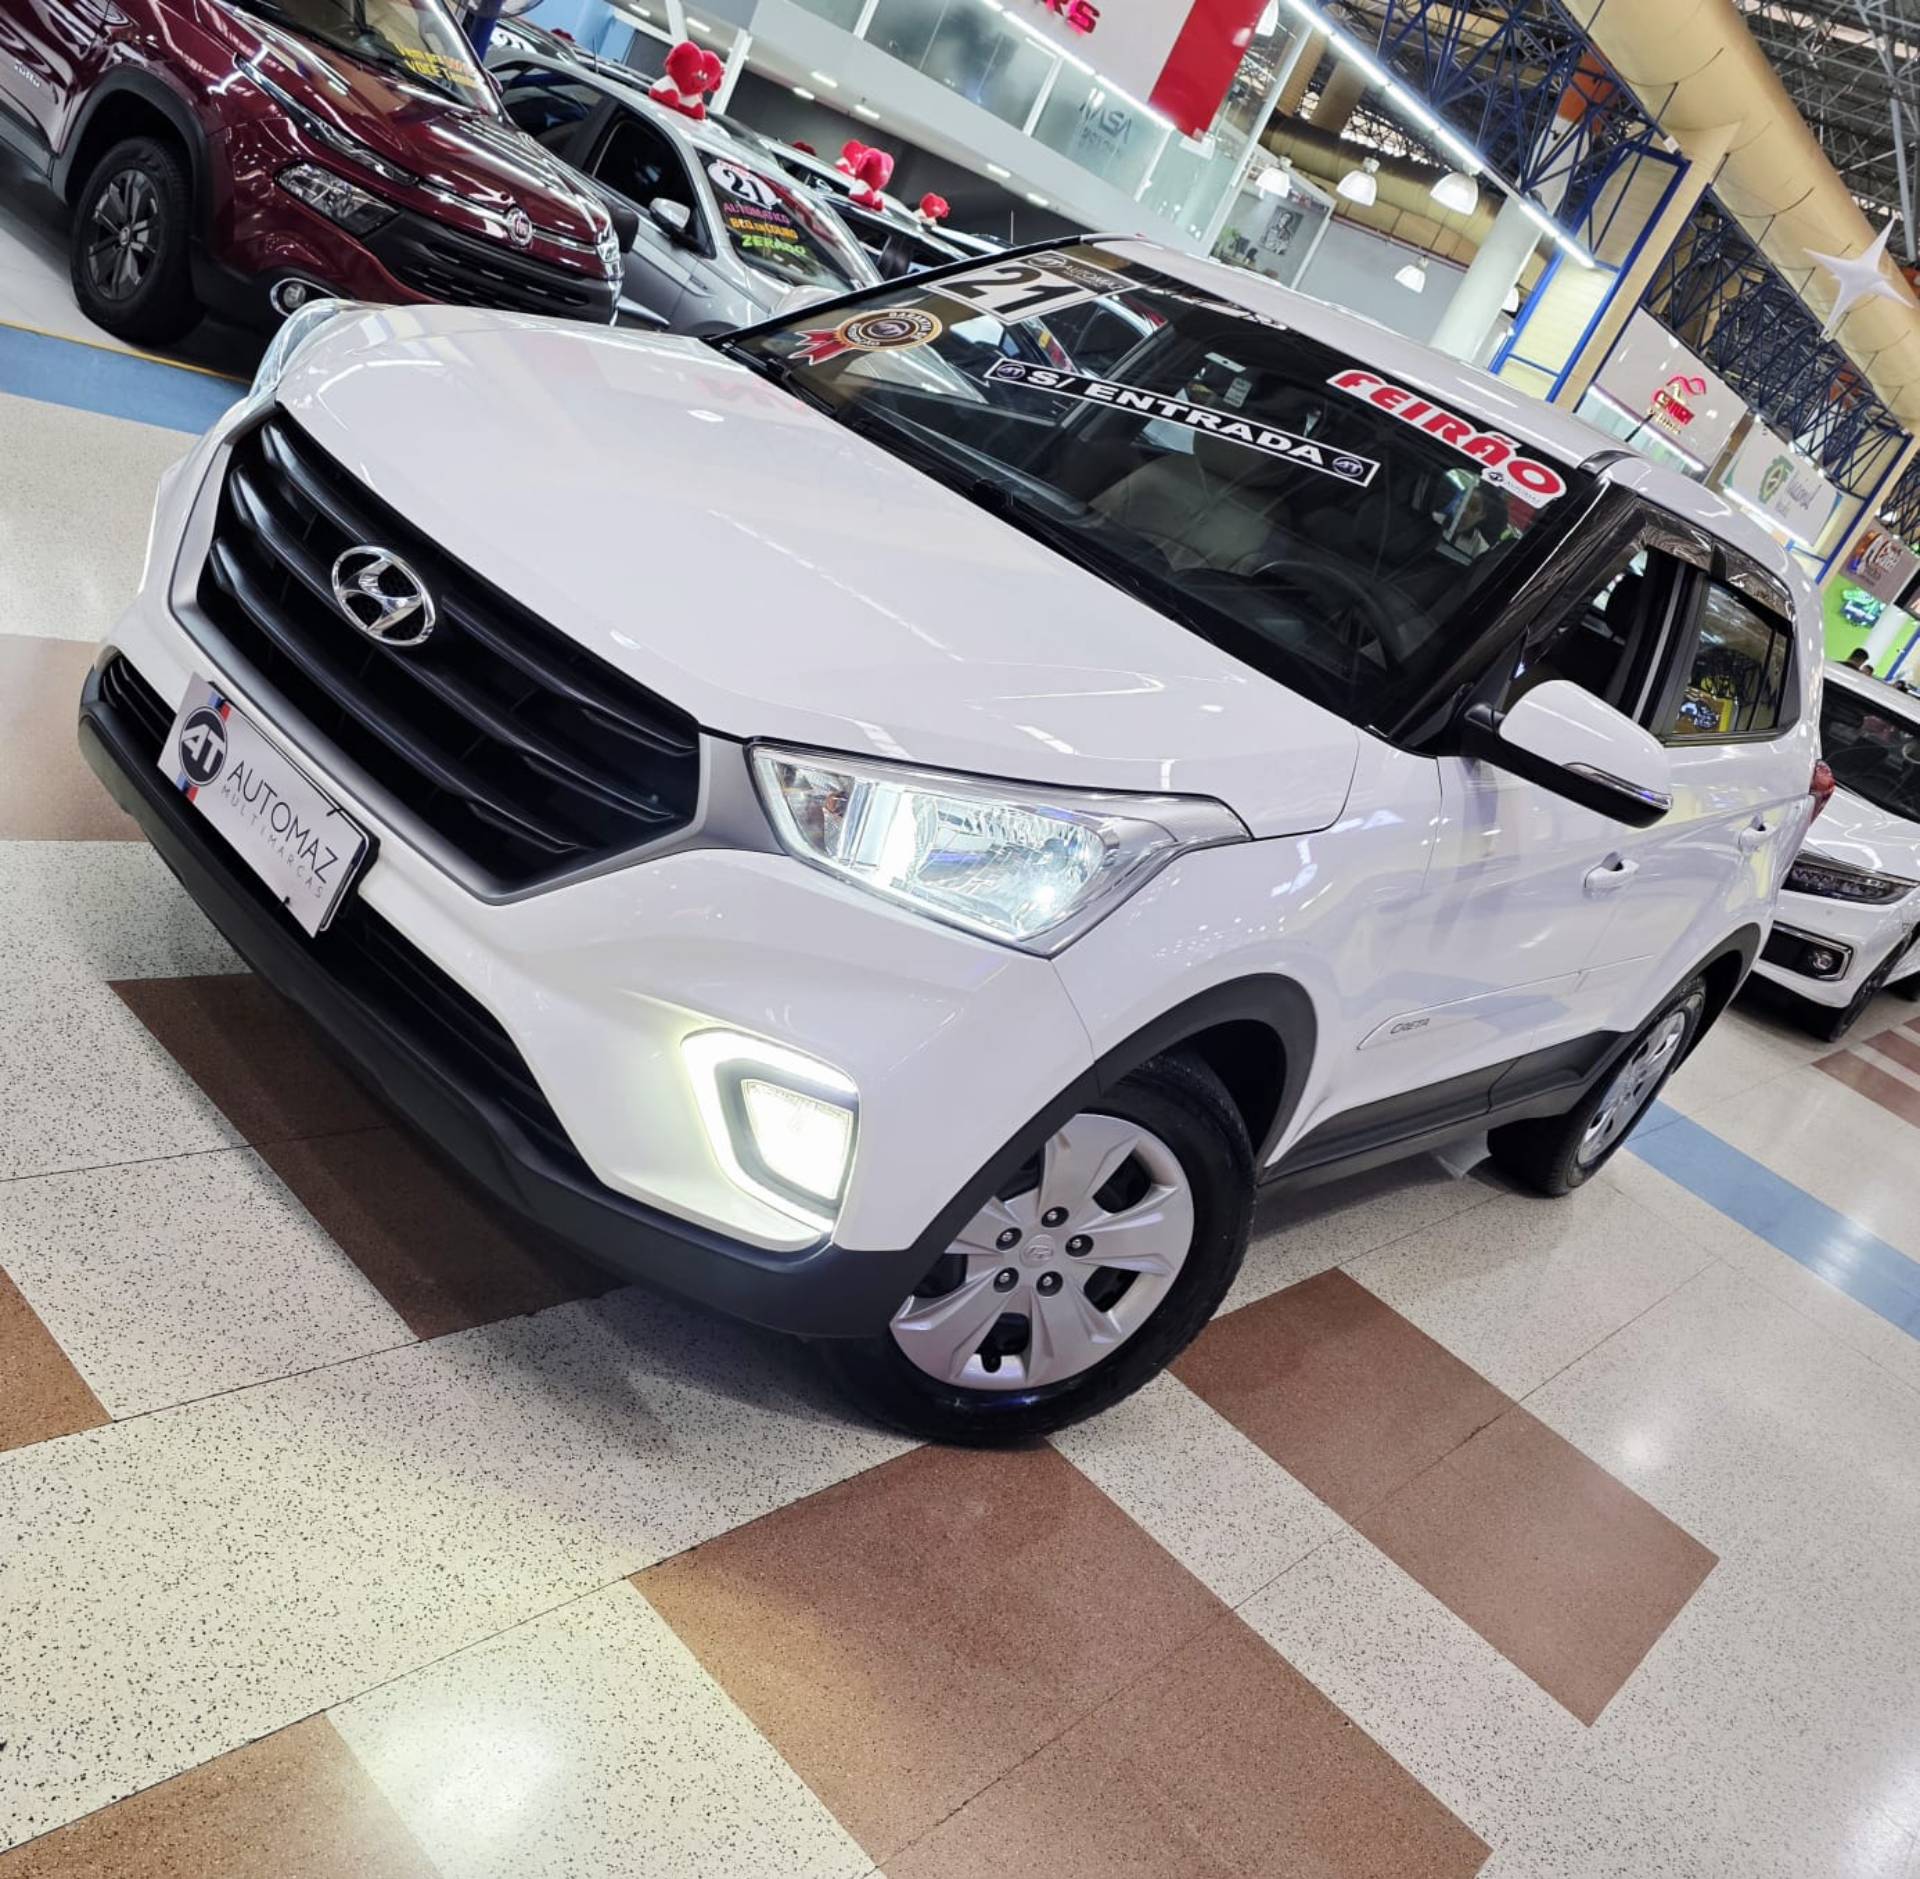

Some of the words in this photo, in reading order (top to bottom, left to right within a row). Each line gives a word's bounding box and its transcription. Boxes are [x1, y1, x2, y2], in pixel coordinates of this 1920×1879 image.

[722, 168, 763, 203] 21
[937, 265, 1086, 315] 21
[1026, 369, 1067, 389] S/
[1083, 385, 1325, 465] ENTRADA
[1334, 372, 1561, 494] FEIRÃO
[180, 722, 225, 775] AT
[220, 785, 324, 899] MULTIMARCAS
[227, 759, 339, 885] AUTOMAZ
